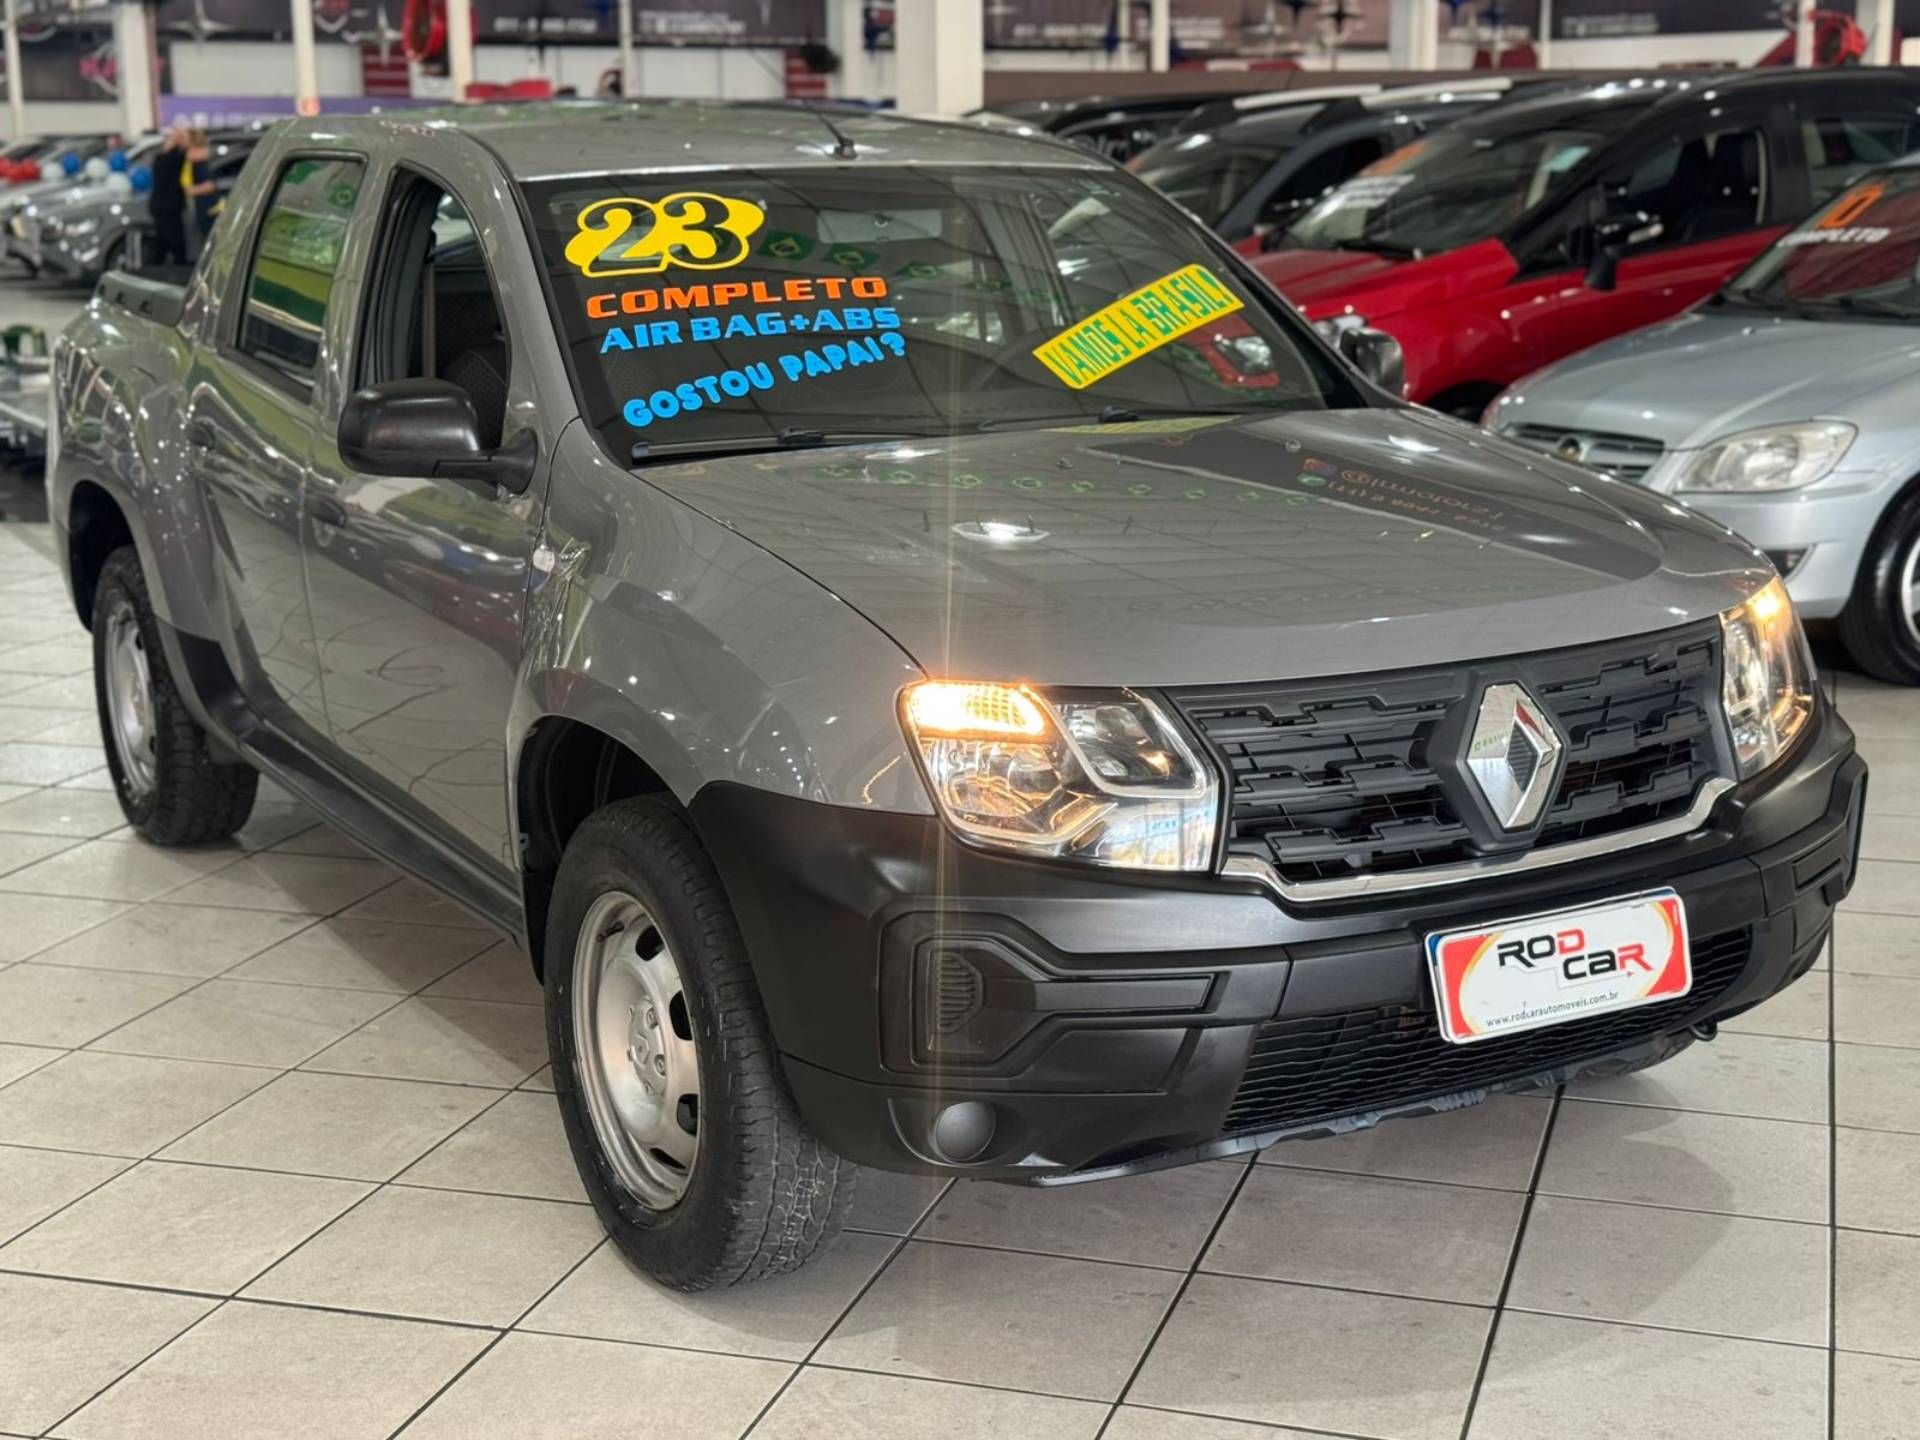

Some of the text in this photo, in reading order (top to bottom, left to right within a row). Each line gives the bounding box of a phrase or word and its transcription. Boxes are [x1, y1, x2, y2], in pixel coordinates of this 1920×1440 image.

[572, 192, 757, 277] 23
[586, 276, 888, 319] COMPLETO
[599, 307, 901, 354] AIR BAG+ABS
[1043, 319, 1132, 385] VAMOS
[1129, 268, 1234, 336] BRASIL!
[623, 331, 906, 427] GOSTOU PAPAI?
[1497, 928, 1586, 968] ROD
[1486, 990, 1619, 1027] www.rodcarautomoveis.com.br
